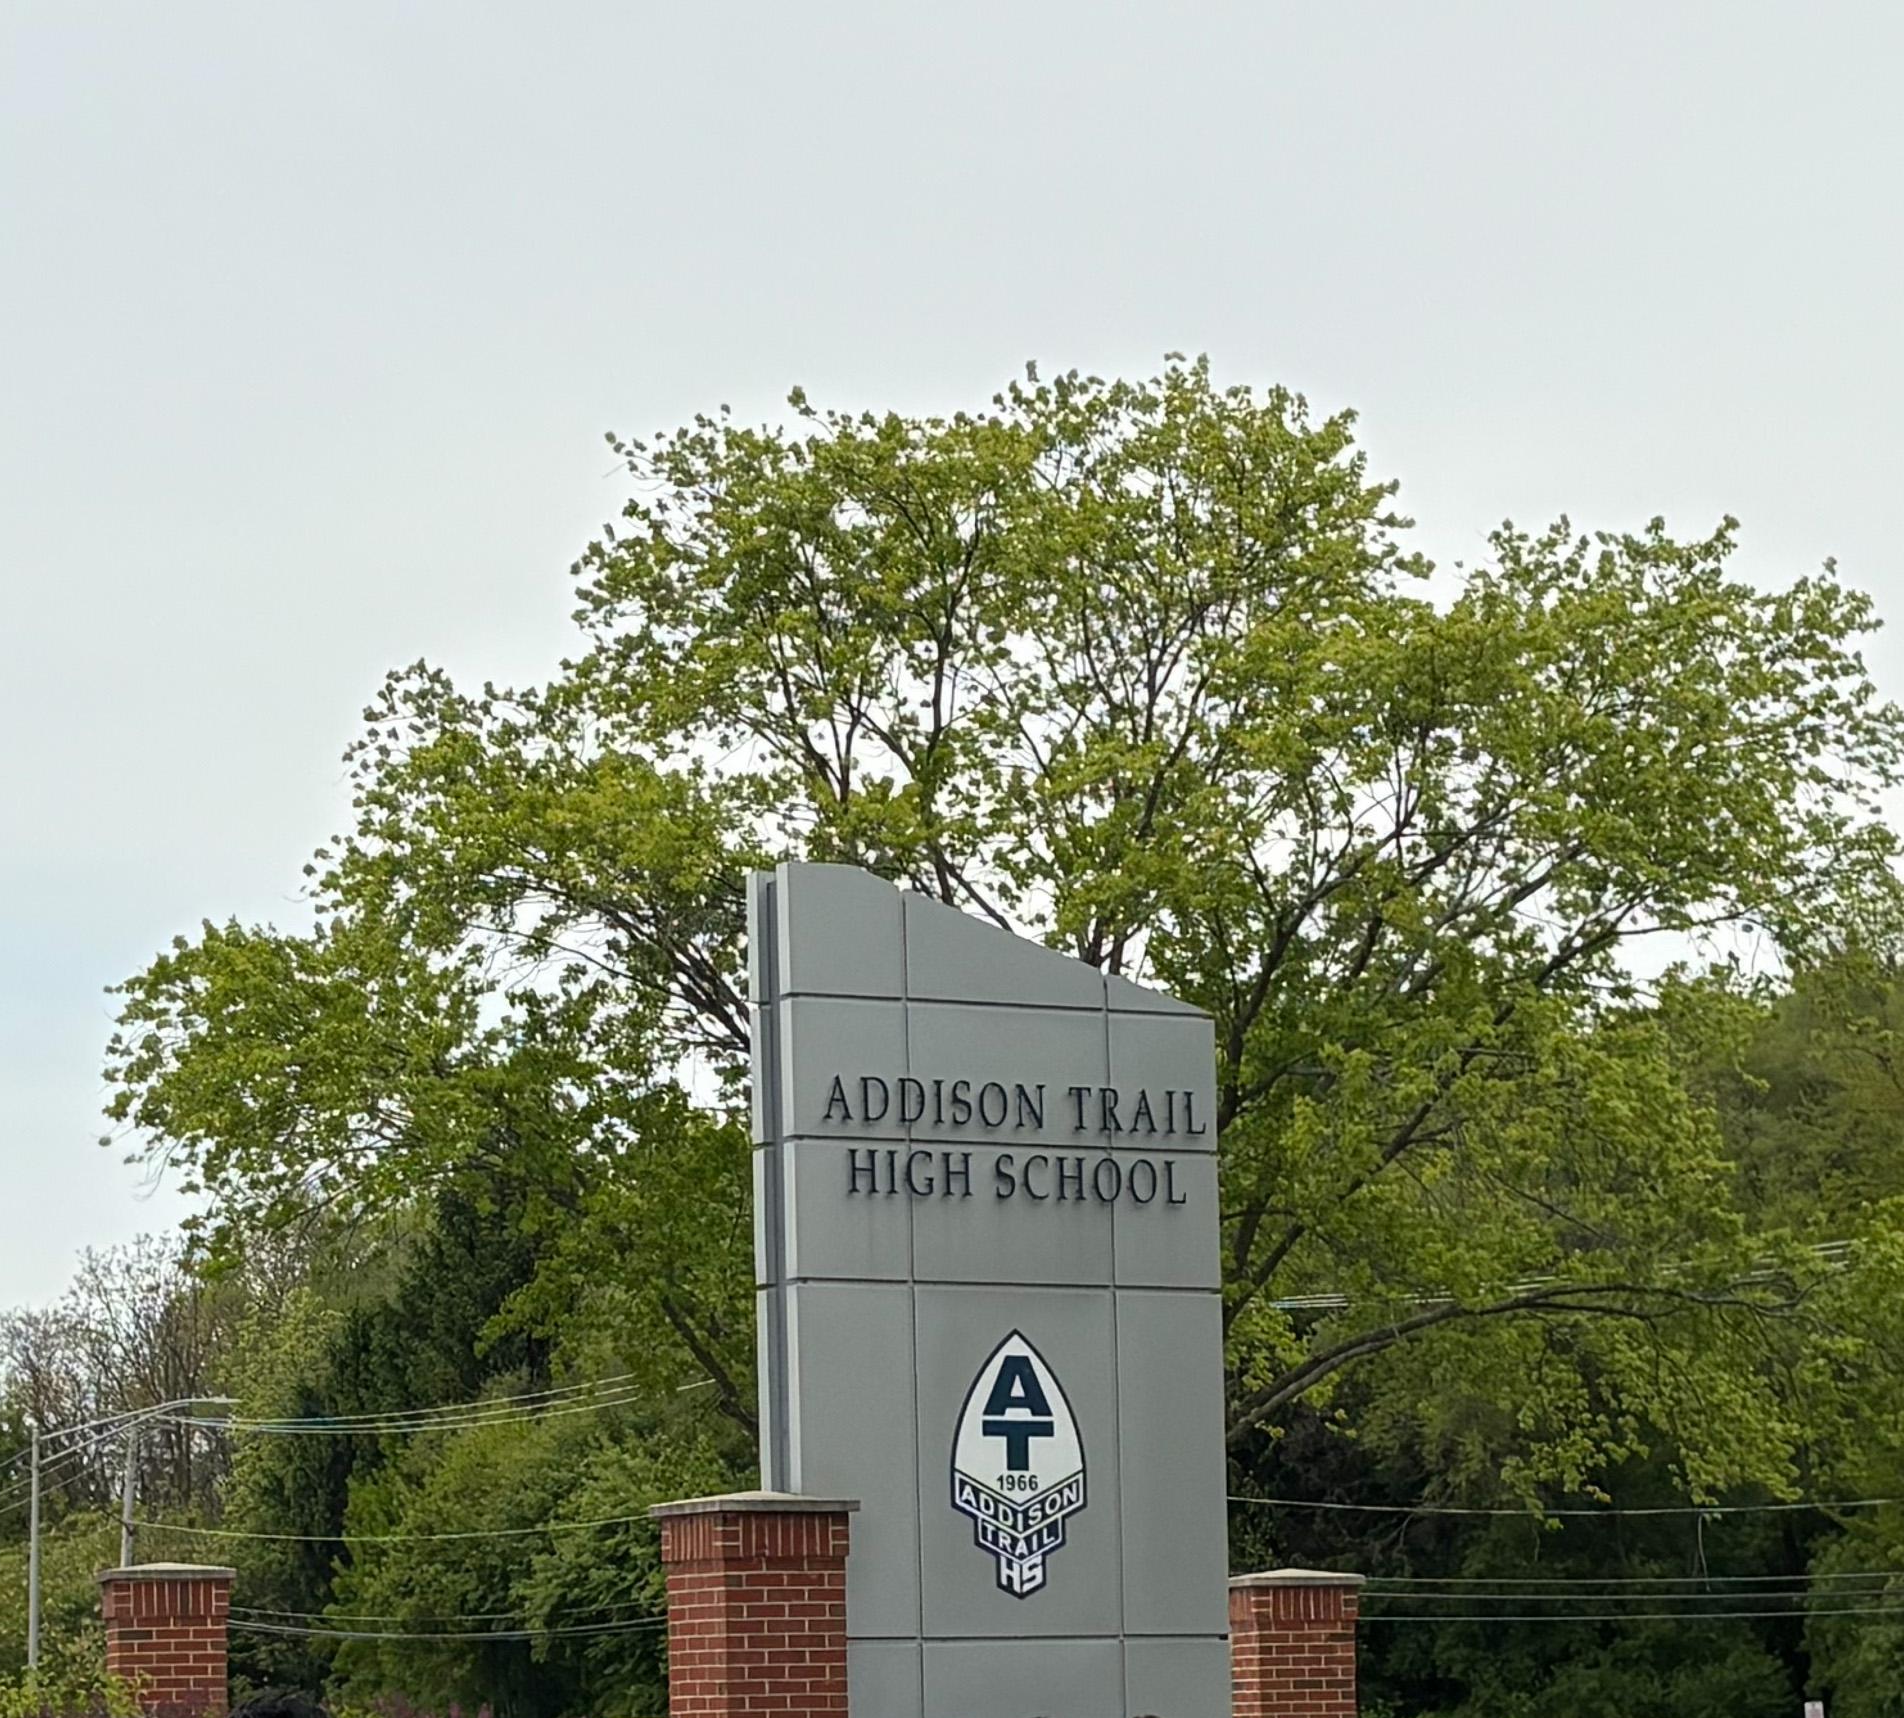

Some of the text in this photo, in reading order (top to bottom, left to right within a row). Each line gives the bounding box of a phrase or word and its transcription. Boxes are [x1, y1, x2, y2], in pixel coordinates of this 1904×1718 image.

[824, 1073, 1207, 1135] ADDISON TRAIL
[848, 1148, 1187, 1204] HIGH SCHOOL
[996, 1475, 1039, 1491] 1966
[960, 1482, 1079, 1532] ADDISON
[983, 1524, 1056, 1556] TRAIL
[1000, 1555, 1044, 1593] HS
